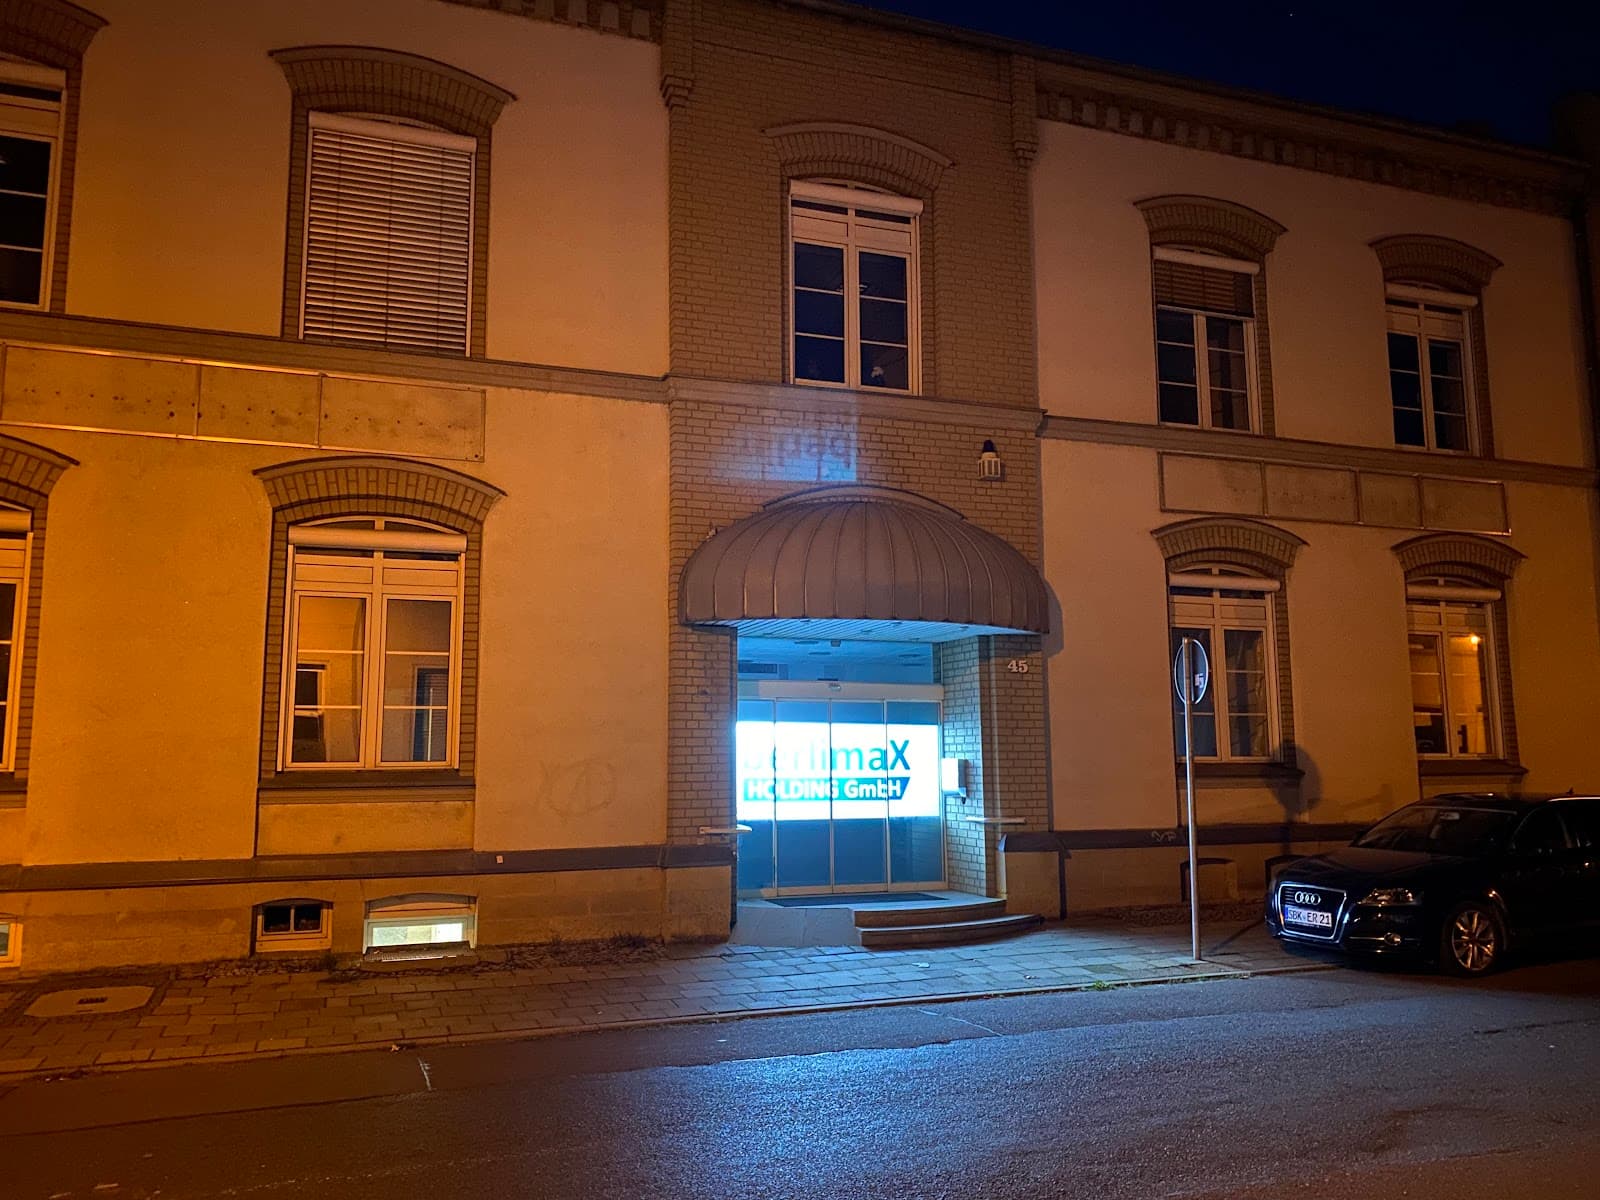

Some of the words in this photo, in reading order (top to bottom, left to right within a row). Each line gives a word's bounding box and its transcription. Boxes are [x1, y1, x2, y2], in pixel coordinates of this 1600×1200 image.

[1008, 659, 1028, 673] 45
[747, 779, 839, 799] HOLDING
[844, 779, 901, 799] GmbH
